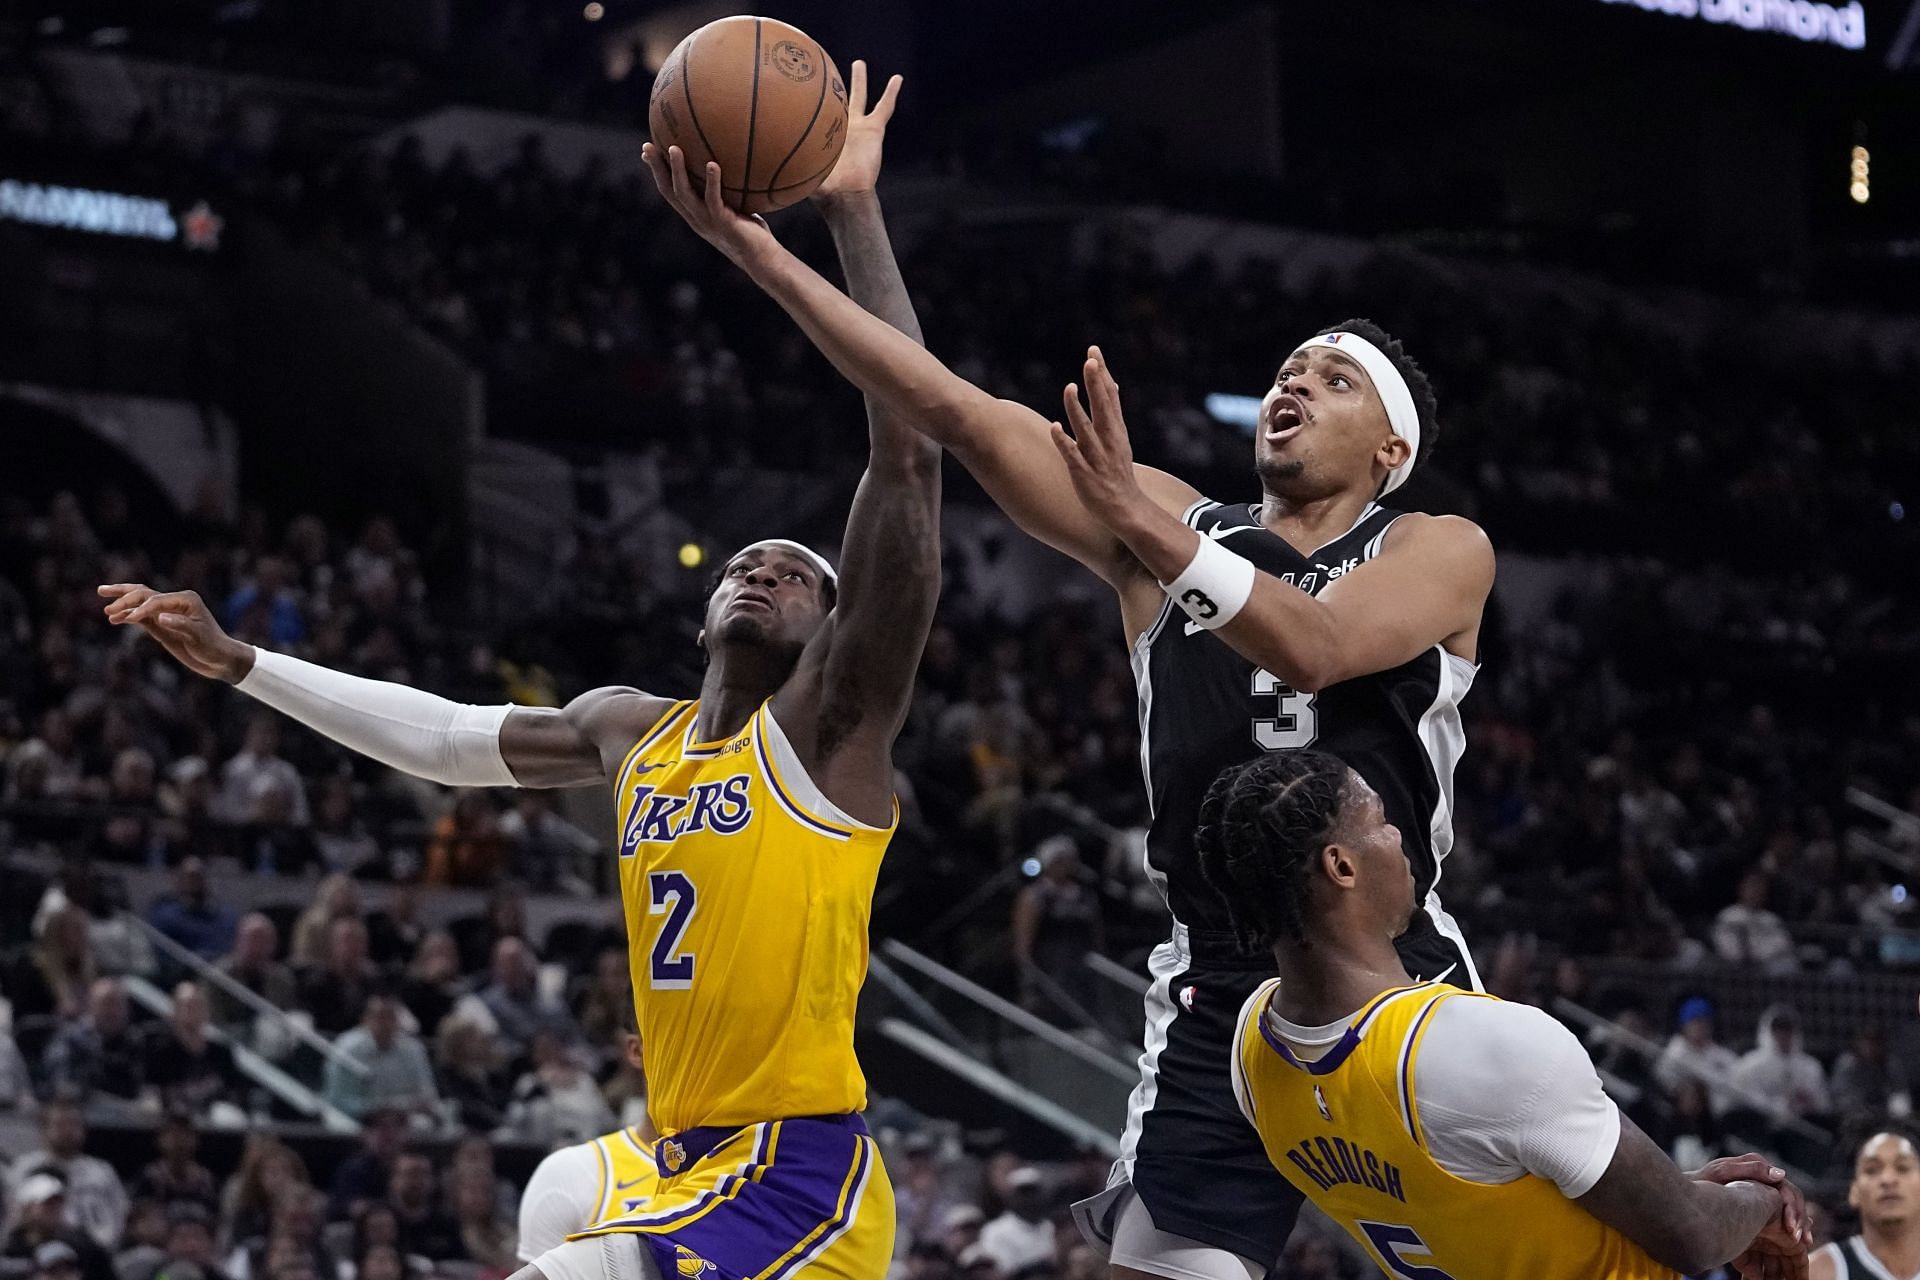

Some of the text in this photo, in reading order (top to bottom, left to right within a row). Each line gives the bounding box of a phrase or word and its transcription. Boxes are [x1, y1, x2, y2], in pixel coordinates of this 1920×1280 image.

[1181, 588, 1219, 620] 3
[1316, 557, 1359, 582] elf
[1251, 666, 1318, 752] 3
[648, 869, 698, 991] 2
[1286, 1135, 1408, 1204] REDDISH
